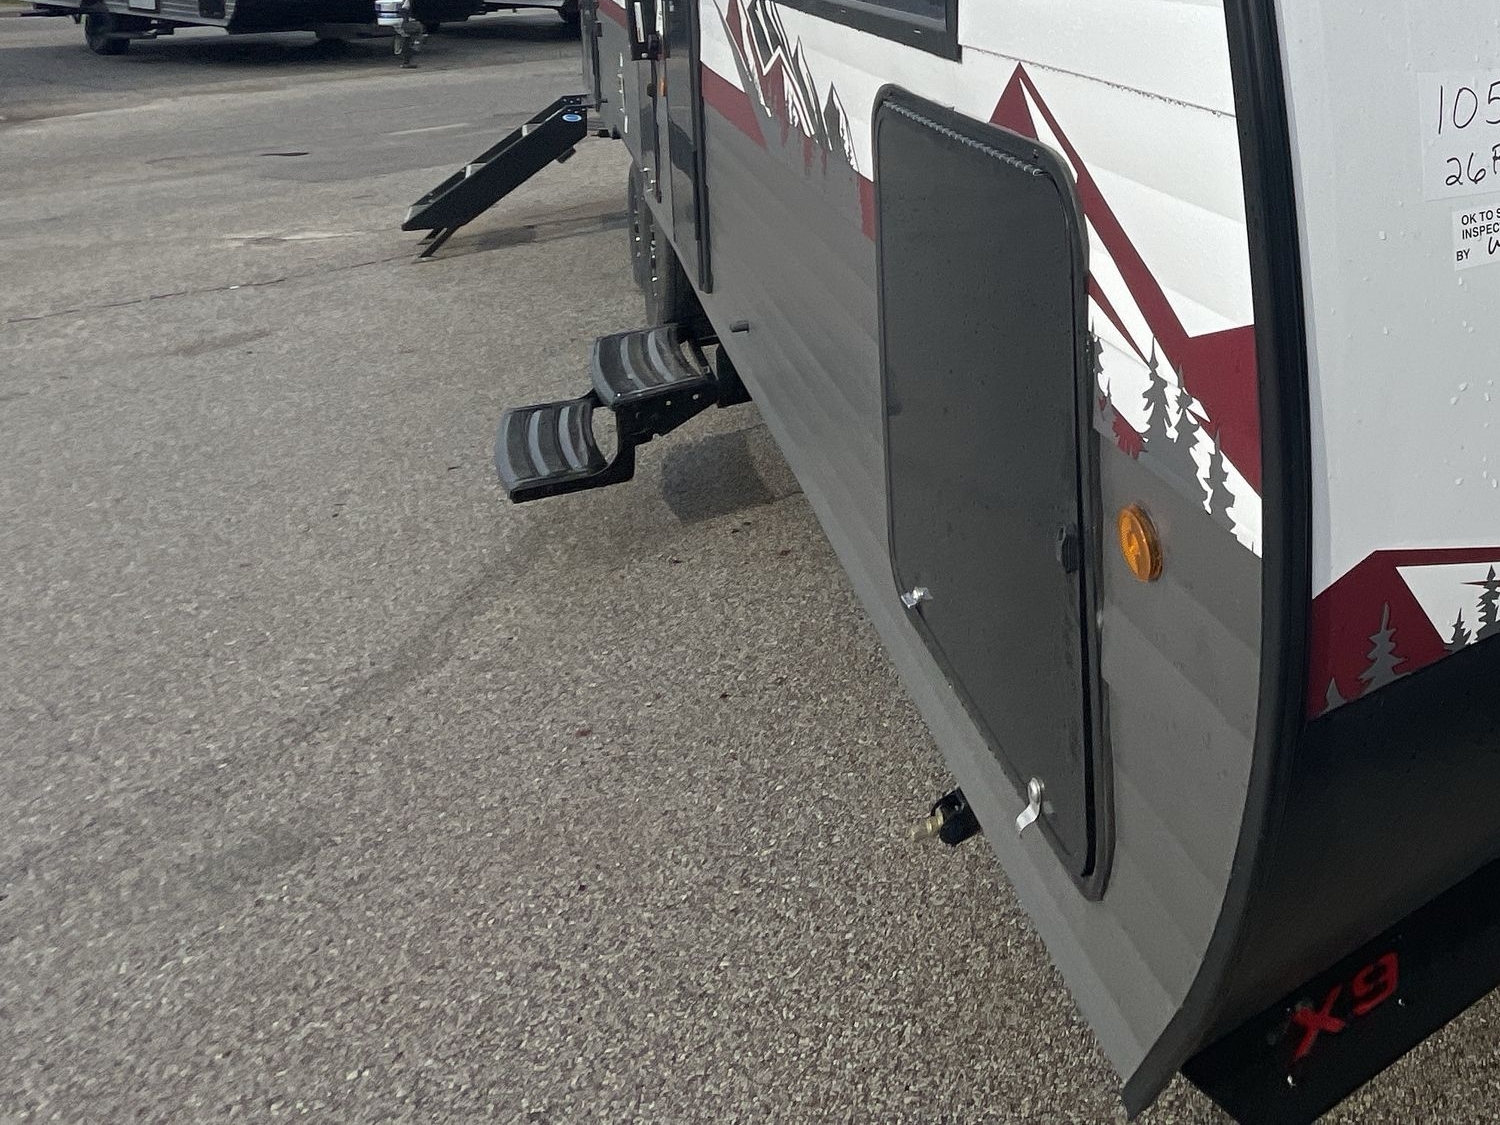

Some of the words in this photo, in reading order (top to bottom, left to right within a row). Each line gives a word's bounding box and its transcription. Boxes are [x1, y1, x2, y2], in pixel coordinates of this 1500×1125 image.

[1461, 213, 1477, 225] OK
[1479, 210, 1494, 221] TO
[1456, 248, 1470, 261] BY
